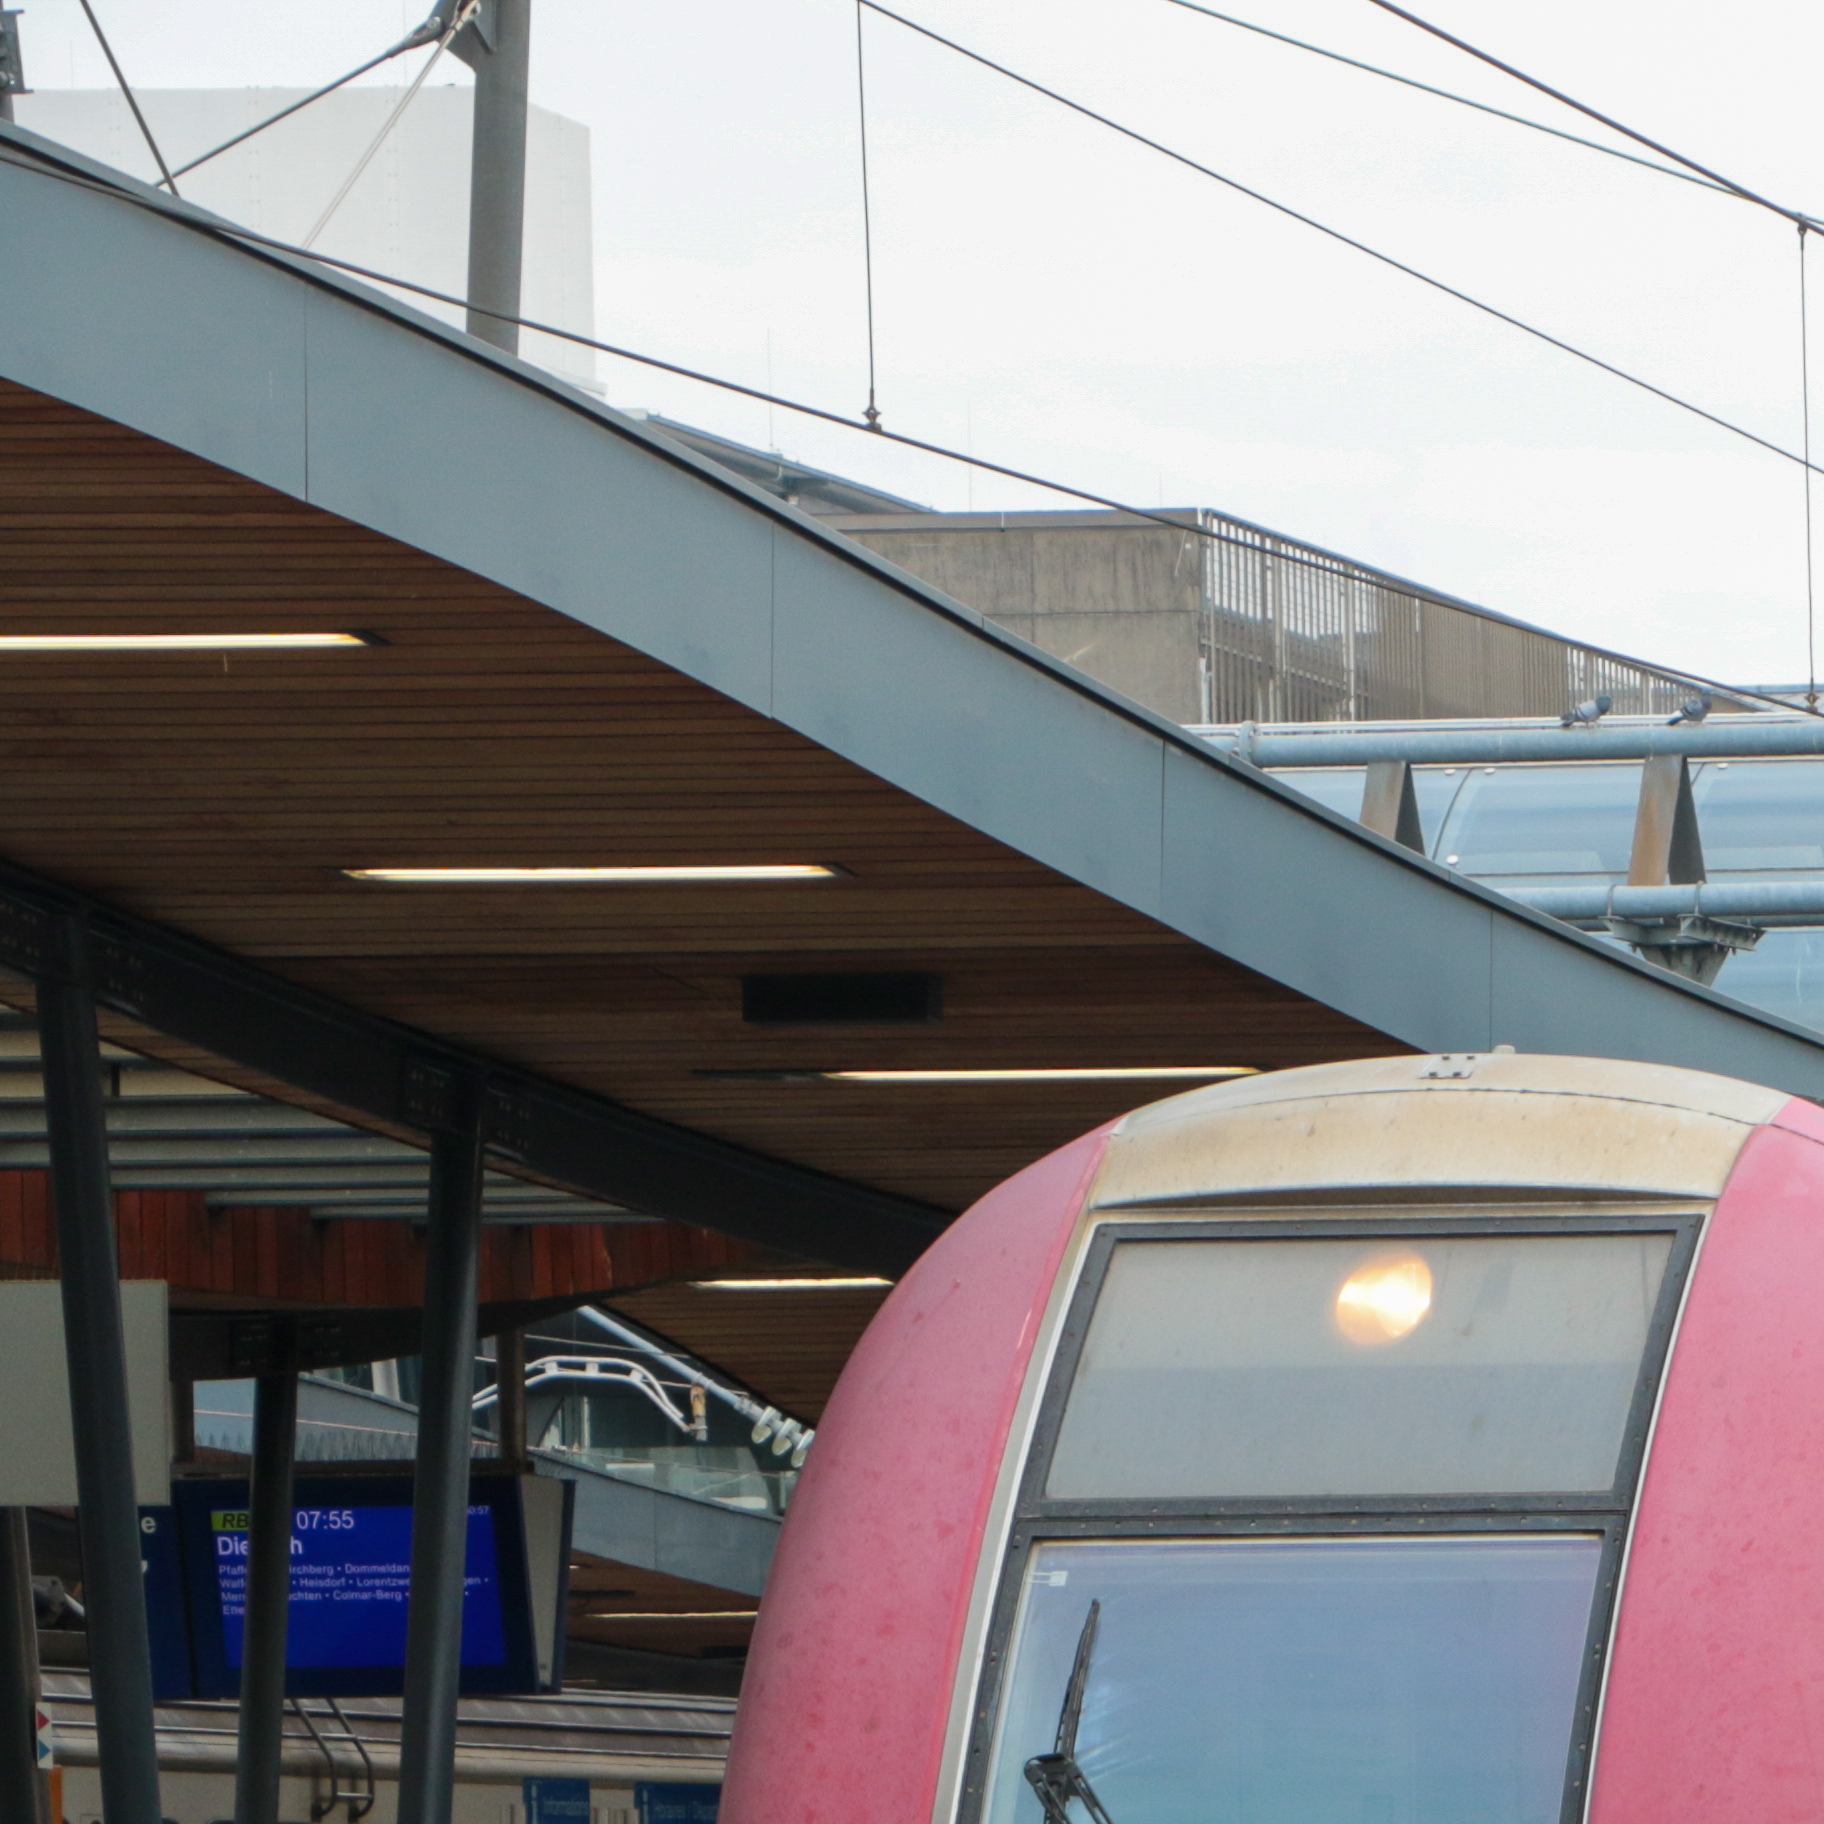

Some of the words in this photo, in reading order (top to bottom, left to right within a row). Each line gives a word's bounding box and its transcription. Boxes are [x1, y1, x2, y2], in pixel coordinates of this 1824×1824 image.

[295, 1510, 355, 1530] 07:55
[344, 1563, 411, 1575] Dommeldan
[332, 1589, 402, 1603] Colmar-Berg
